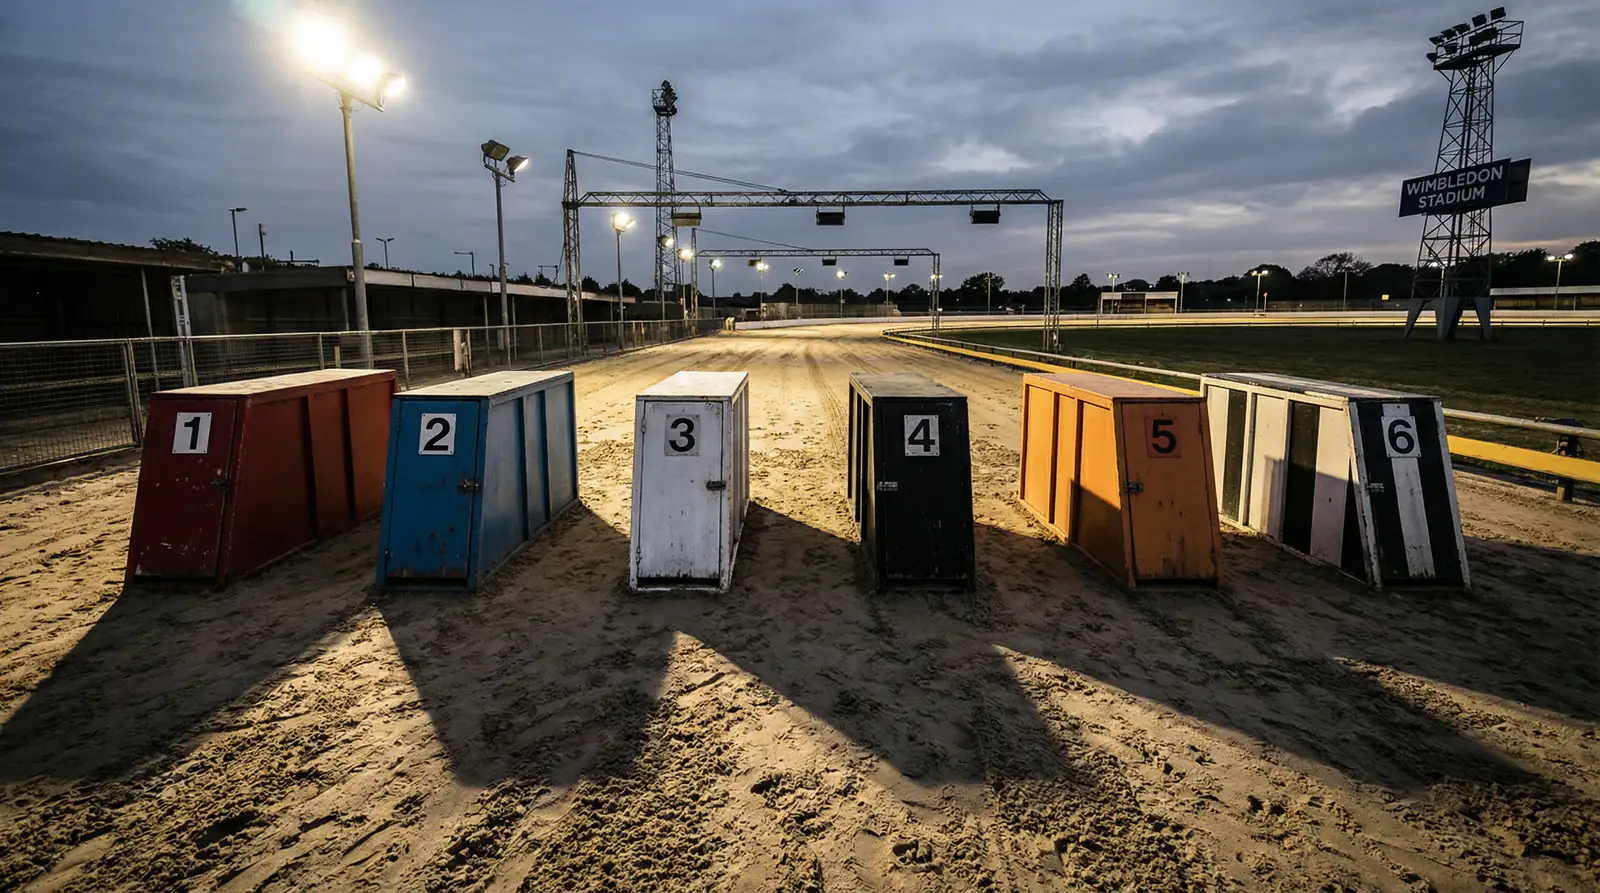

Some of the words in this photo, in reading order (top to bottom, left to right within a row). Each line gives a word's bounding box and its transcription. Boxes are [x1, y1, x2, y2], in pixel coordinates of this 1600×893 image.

[1407, 165, 1503, 195] WIMBLEDON
[1418, 185, 1485, 208] STADIUM
[183, 416, 201, 450] 1
[423, 417, 451, 451] 2
[668, 418, 696, 453] 3
[907, 418, 936, 453] 4
[1151, 419, 1177, 454] 5
[1387, 419, 1415, 455] 6
